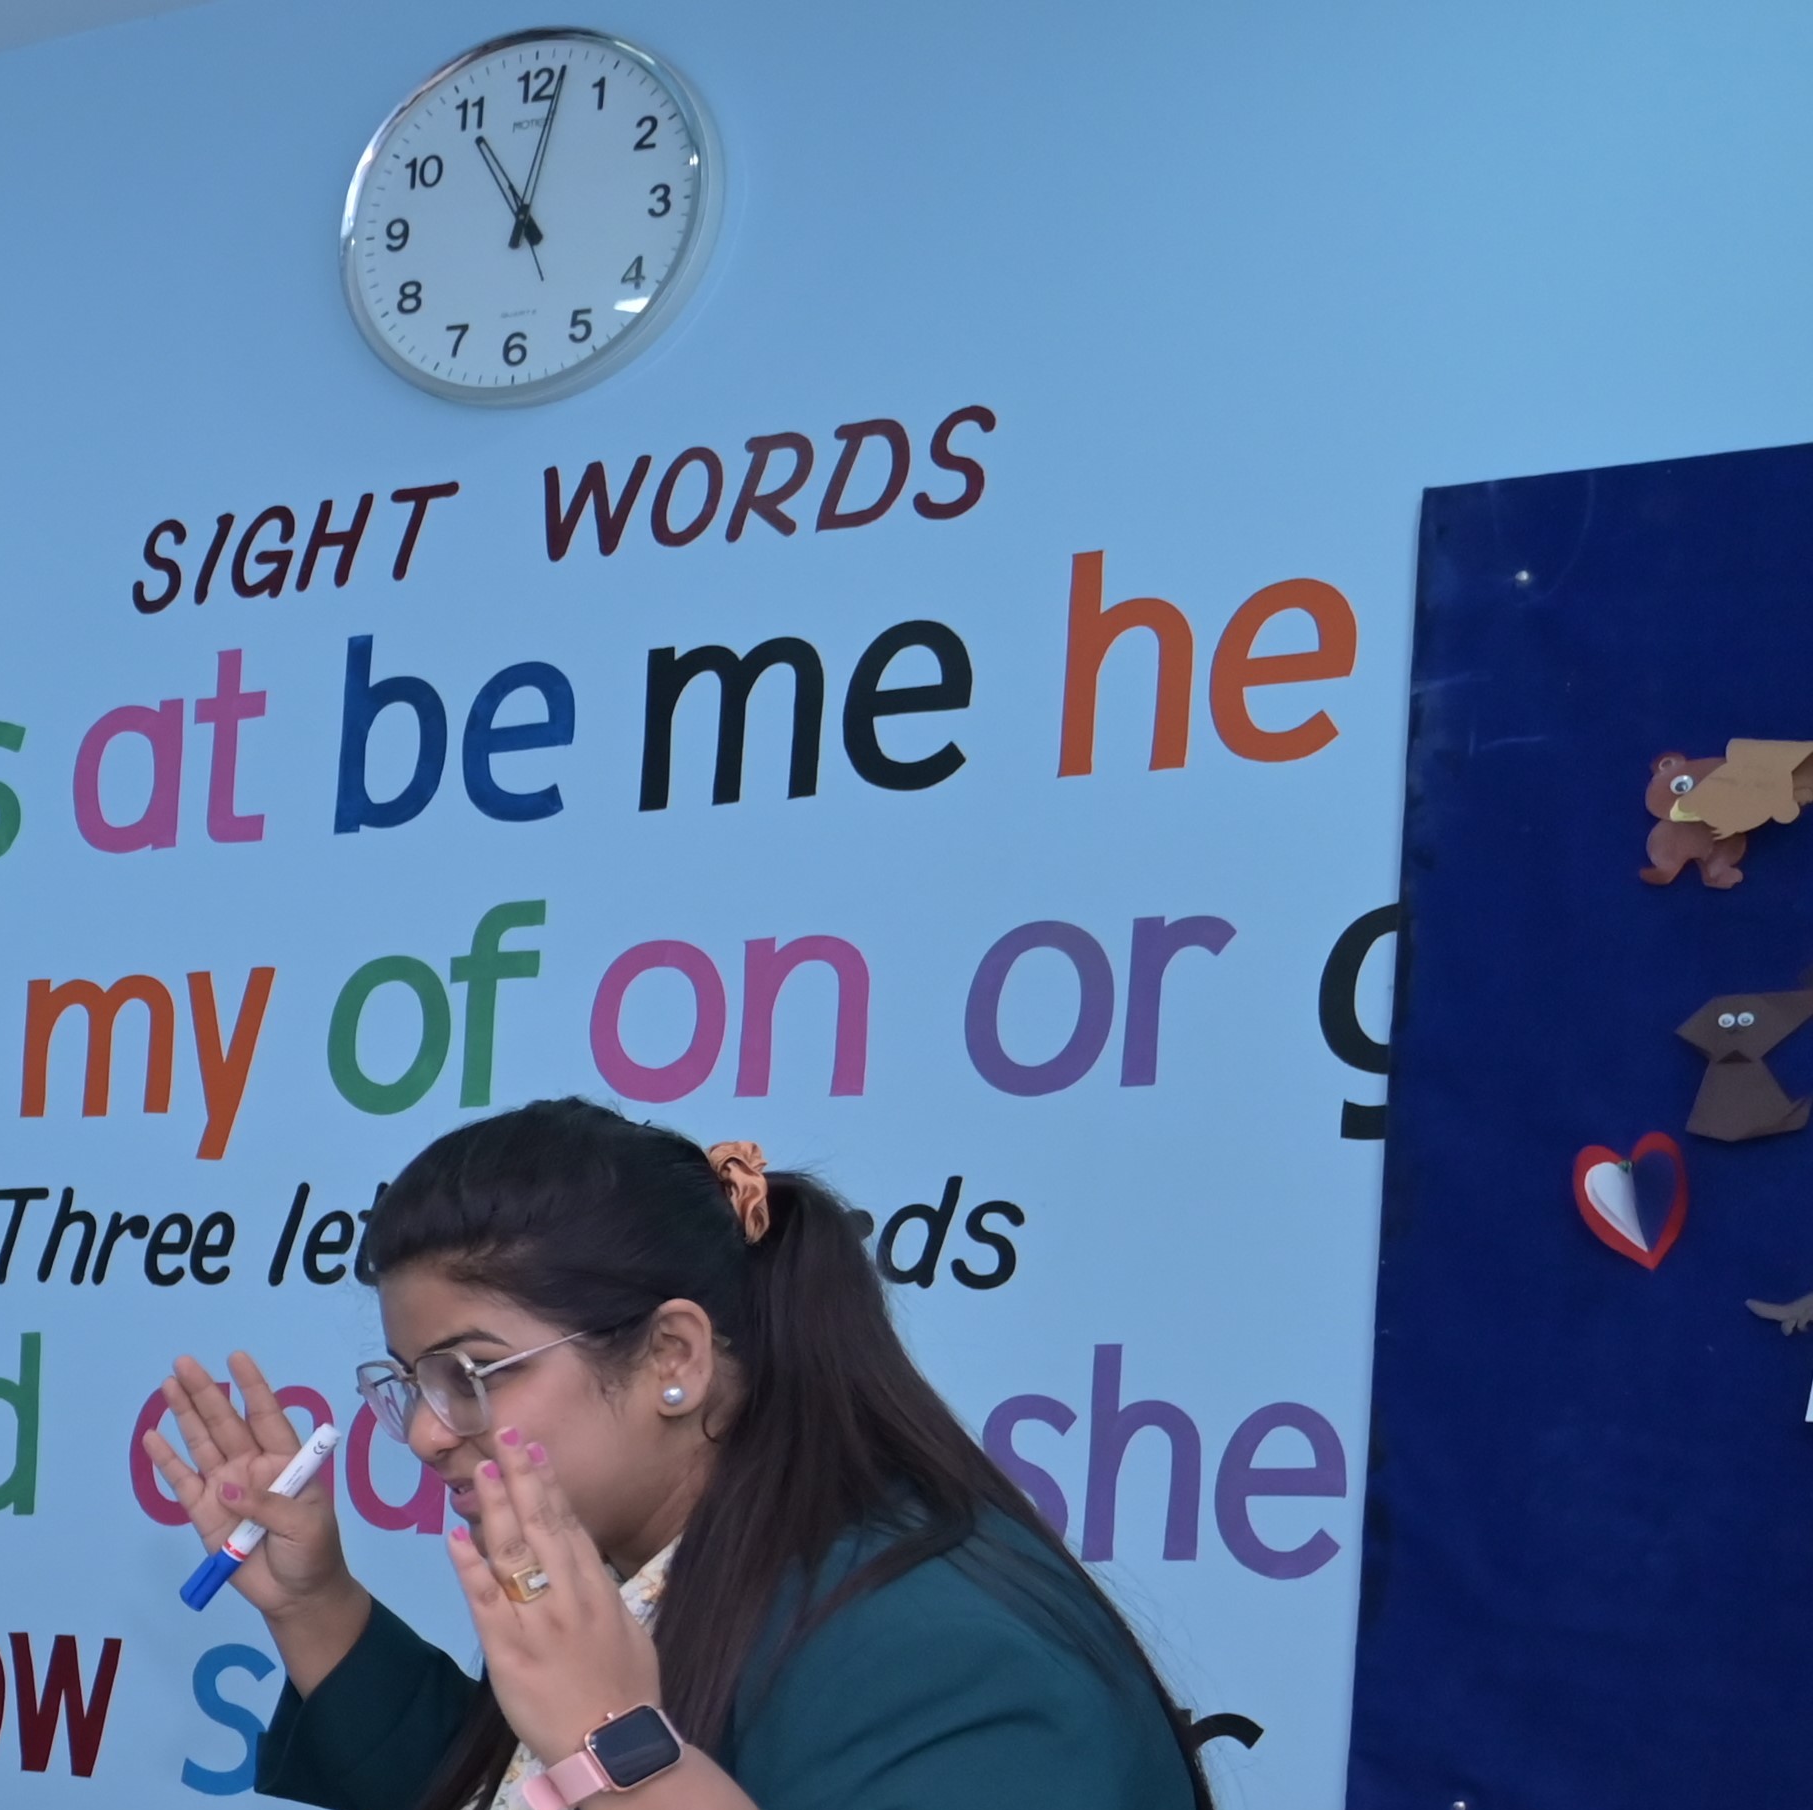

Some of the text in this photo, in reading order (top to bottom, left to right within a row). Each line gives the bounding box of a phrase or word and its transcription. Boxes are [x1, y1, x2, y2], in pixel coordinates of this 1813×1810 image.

[518, 67, 555, 103] 12
[591, 76, 606, 110] 1
[456, 96, 485, 131] 11
[633, 116, 658, 151] 2
[405, 155, 444, 190] 10
[648, 184, 672, 218] 3
[385, 218, 410, 251] 9
[621, 256, 645, 290] 4
[397, 281, 423, 314] 8
[446, 324, 470, 358] 7
[568, 308, 593, 343] 5
[501, 332, 528, 366] 6
[131, 404, 997, 616] SIGHT WORDS
[73, 648, 267, 852] at
[335, 634, 576, 834] be
[639, 620, 973, 812] me
[1058, 550, 1357, 778] he
[19, 966, 275, 1160] my
[327, 899, 547, 1114] of
[590, 935, 871, 1104] on
[964, 915, 1236, 1096] or
[983, 1344, 1347, 1580] she
